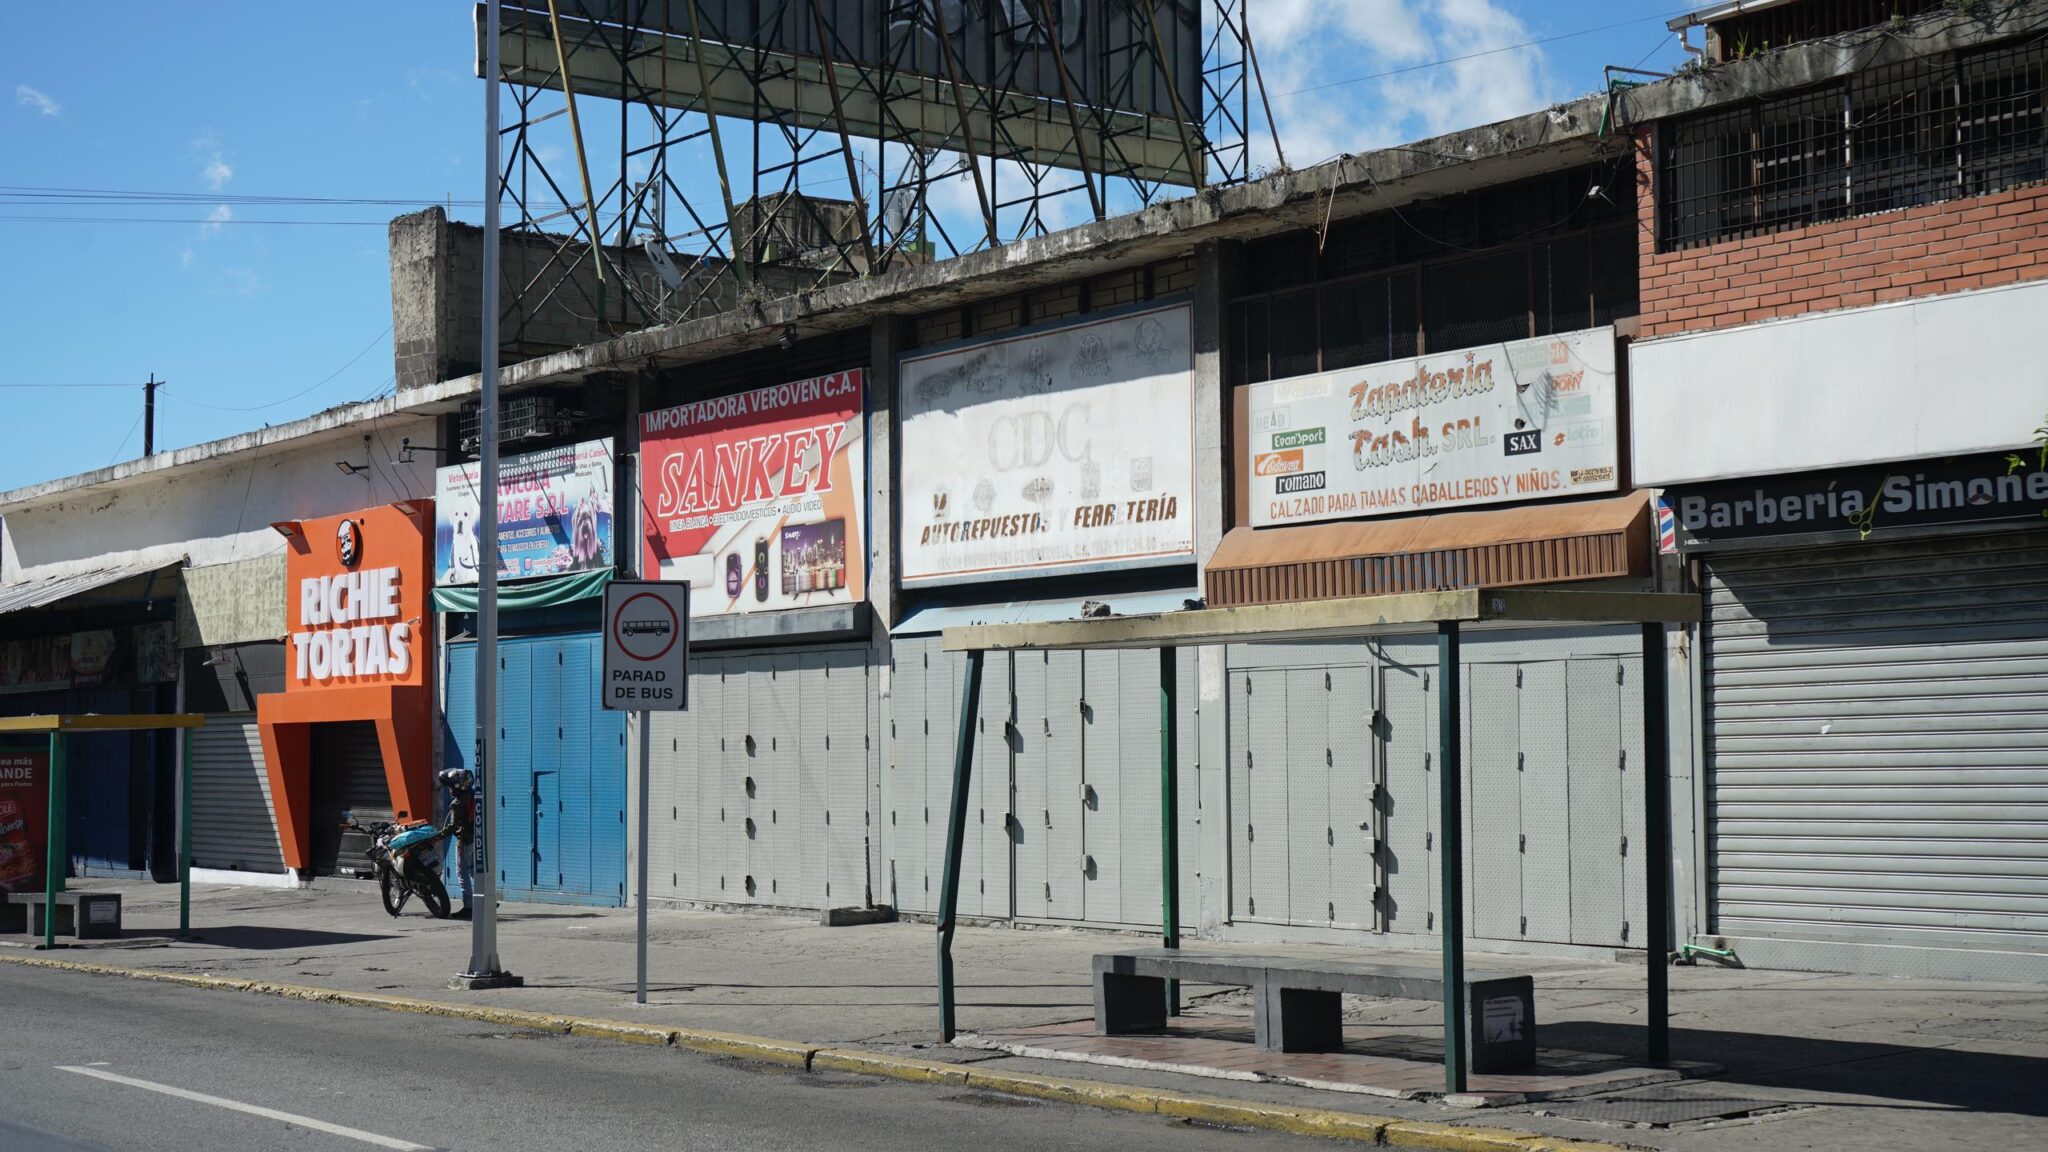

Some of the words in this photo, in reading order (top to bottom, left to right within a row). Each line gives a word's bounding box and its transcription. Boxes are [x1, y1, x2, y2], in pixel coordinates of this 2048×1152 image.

[646, 395, 748, 432] IMPORTADORA
[750, 378, 821, 413] VEROVEN
[824, 372, 856, 397] C.A.
[1349, 351, 1495, 424] Zapateria
[1255, 409, 1285, 430] HEAD
[1510, 433, 1537, 452] SAX
[658, 422, 845, 518] SANKEY
[1278, 472, 1324, 493] romano
[782, 502, 801, 514] AUDIO
[802, 499, 822, 511] VIDEO
[1270, 495, 1325, 520] CALZADO
[1328, 492, 1357, 513] PARA
[1360, 487, 1406, 511] DAMAS
[1411, 476, 1499, 505] CABALLEROS
[1503, 475, 1513, 495] Y
[1681, 480, 1863, 531] Barbería
[301, 567, 400, 625] RICHIE
[293, 622, 411, 680] TORTAS
[613, 670, 666, 682] PARAD
[615, 687, 636, 699] DE
[641, 687, 673, 699] BUS
[13, 756, 33, 766] más
